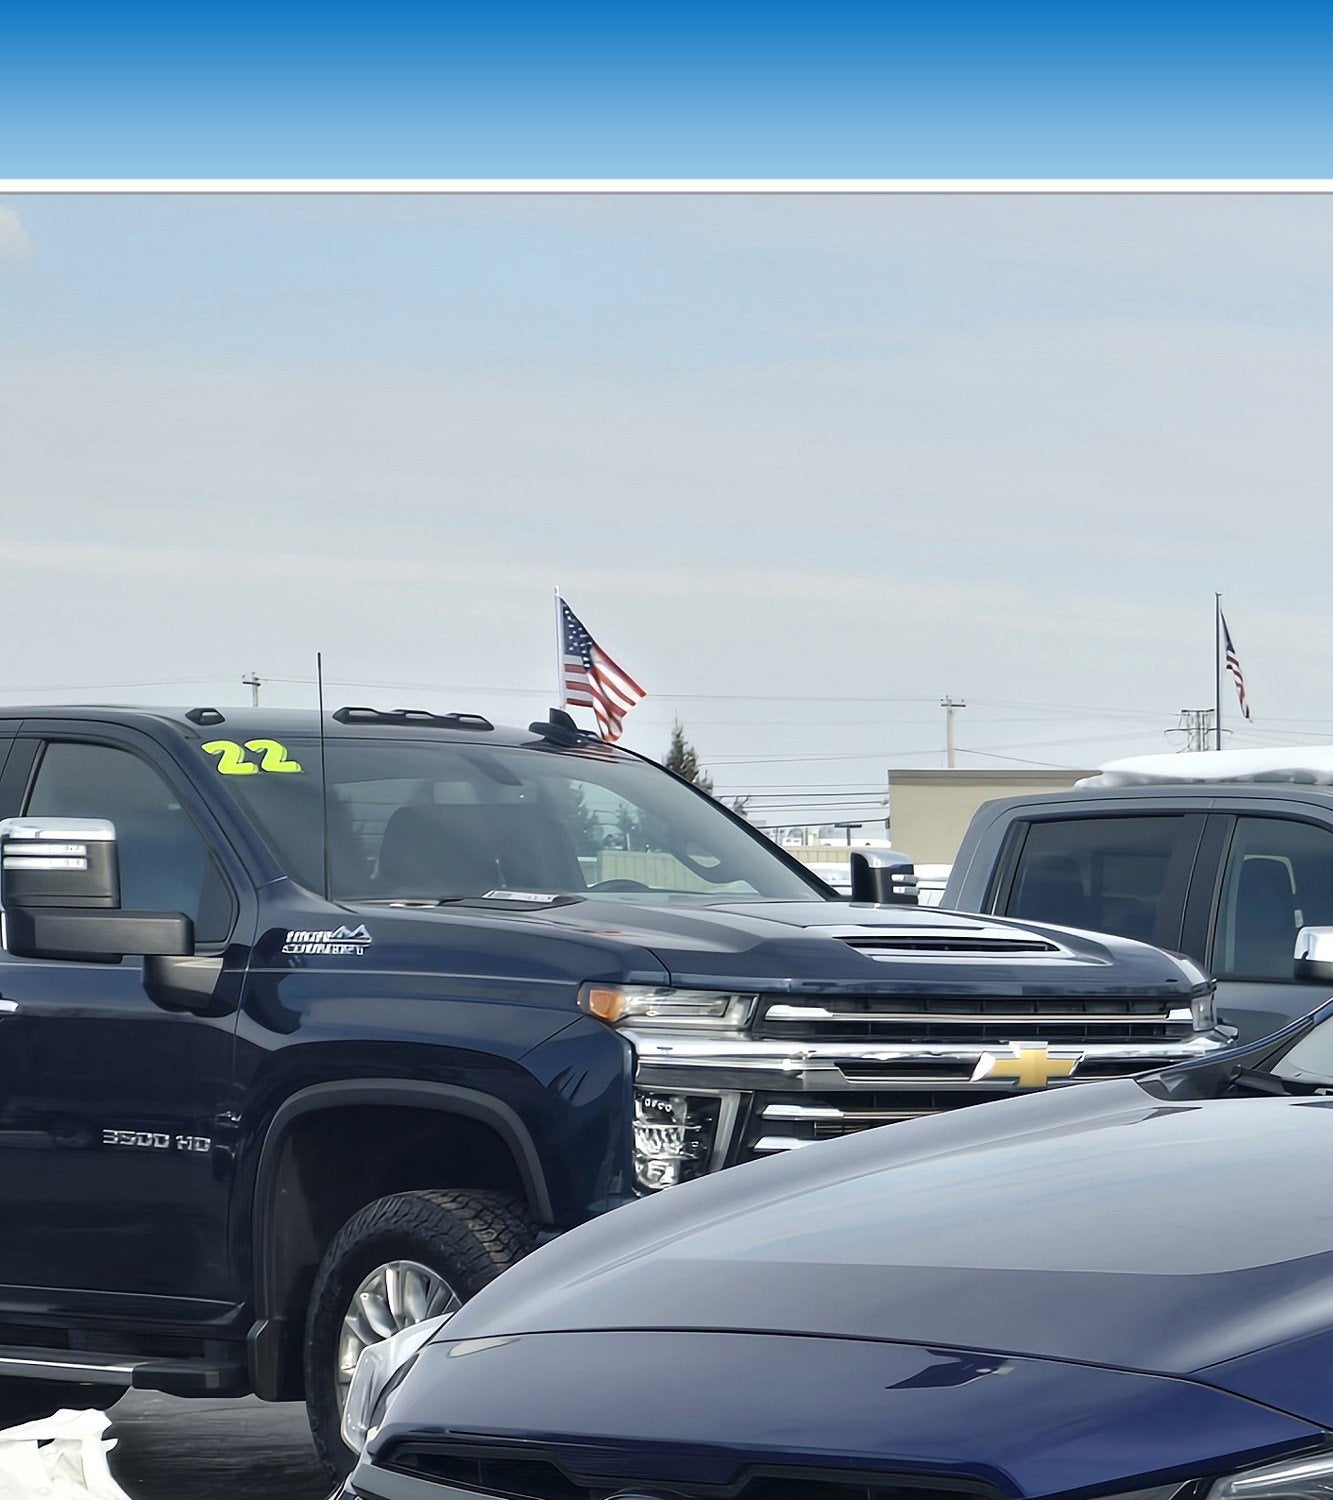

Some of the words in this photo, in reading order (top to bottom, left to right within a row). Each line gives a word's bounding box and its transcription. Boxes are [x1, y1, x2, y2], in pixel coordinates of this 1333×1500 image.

[201, 738, 302, 774] 22
[103, 1129, 170, 1148] 3500
[176, 1135, 211, 1152] HD
